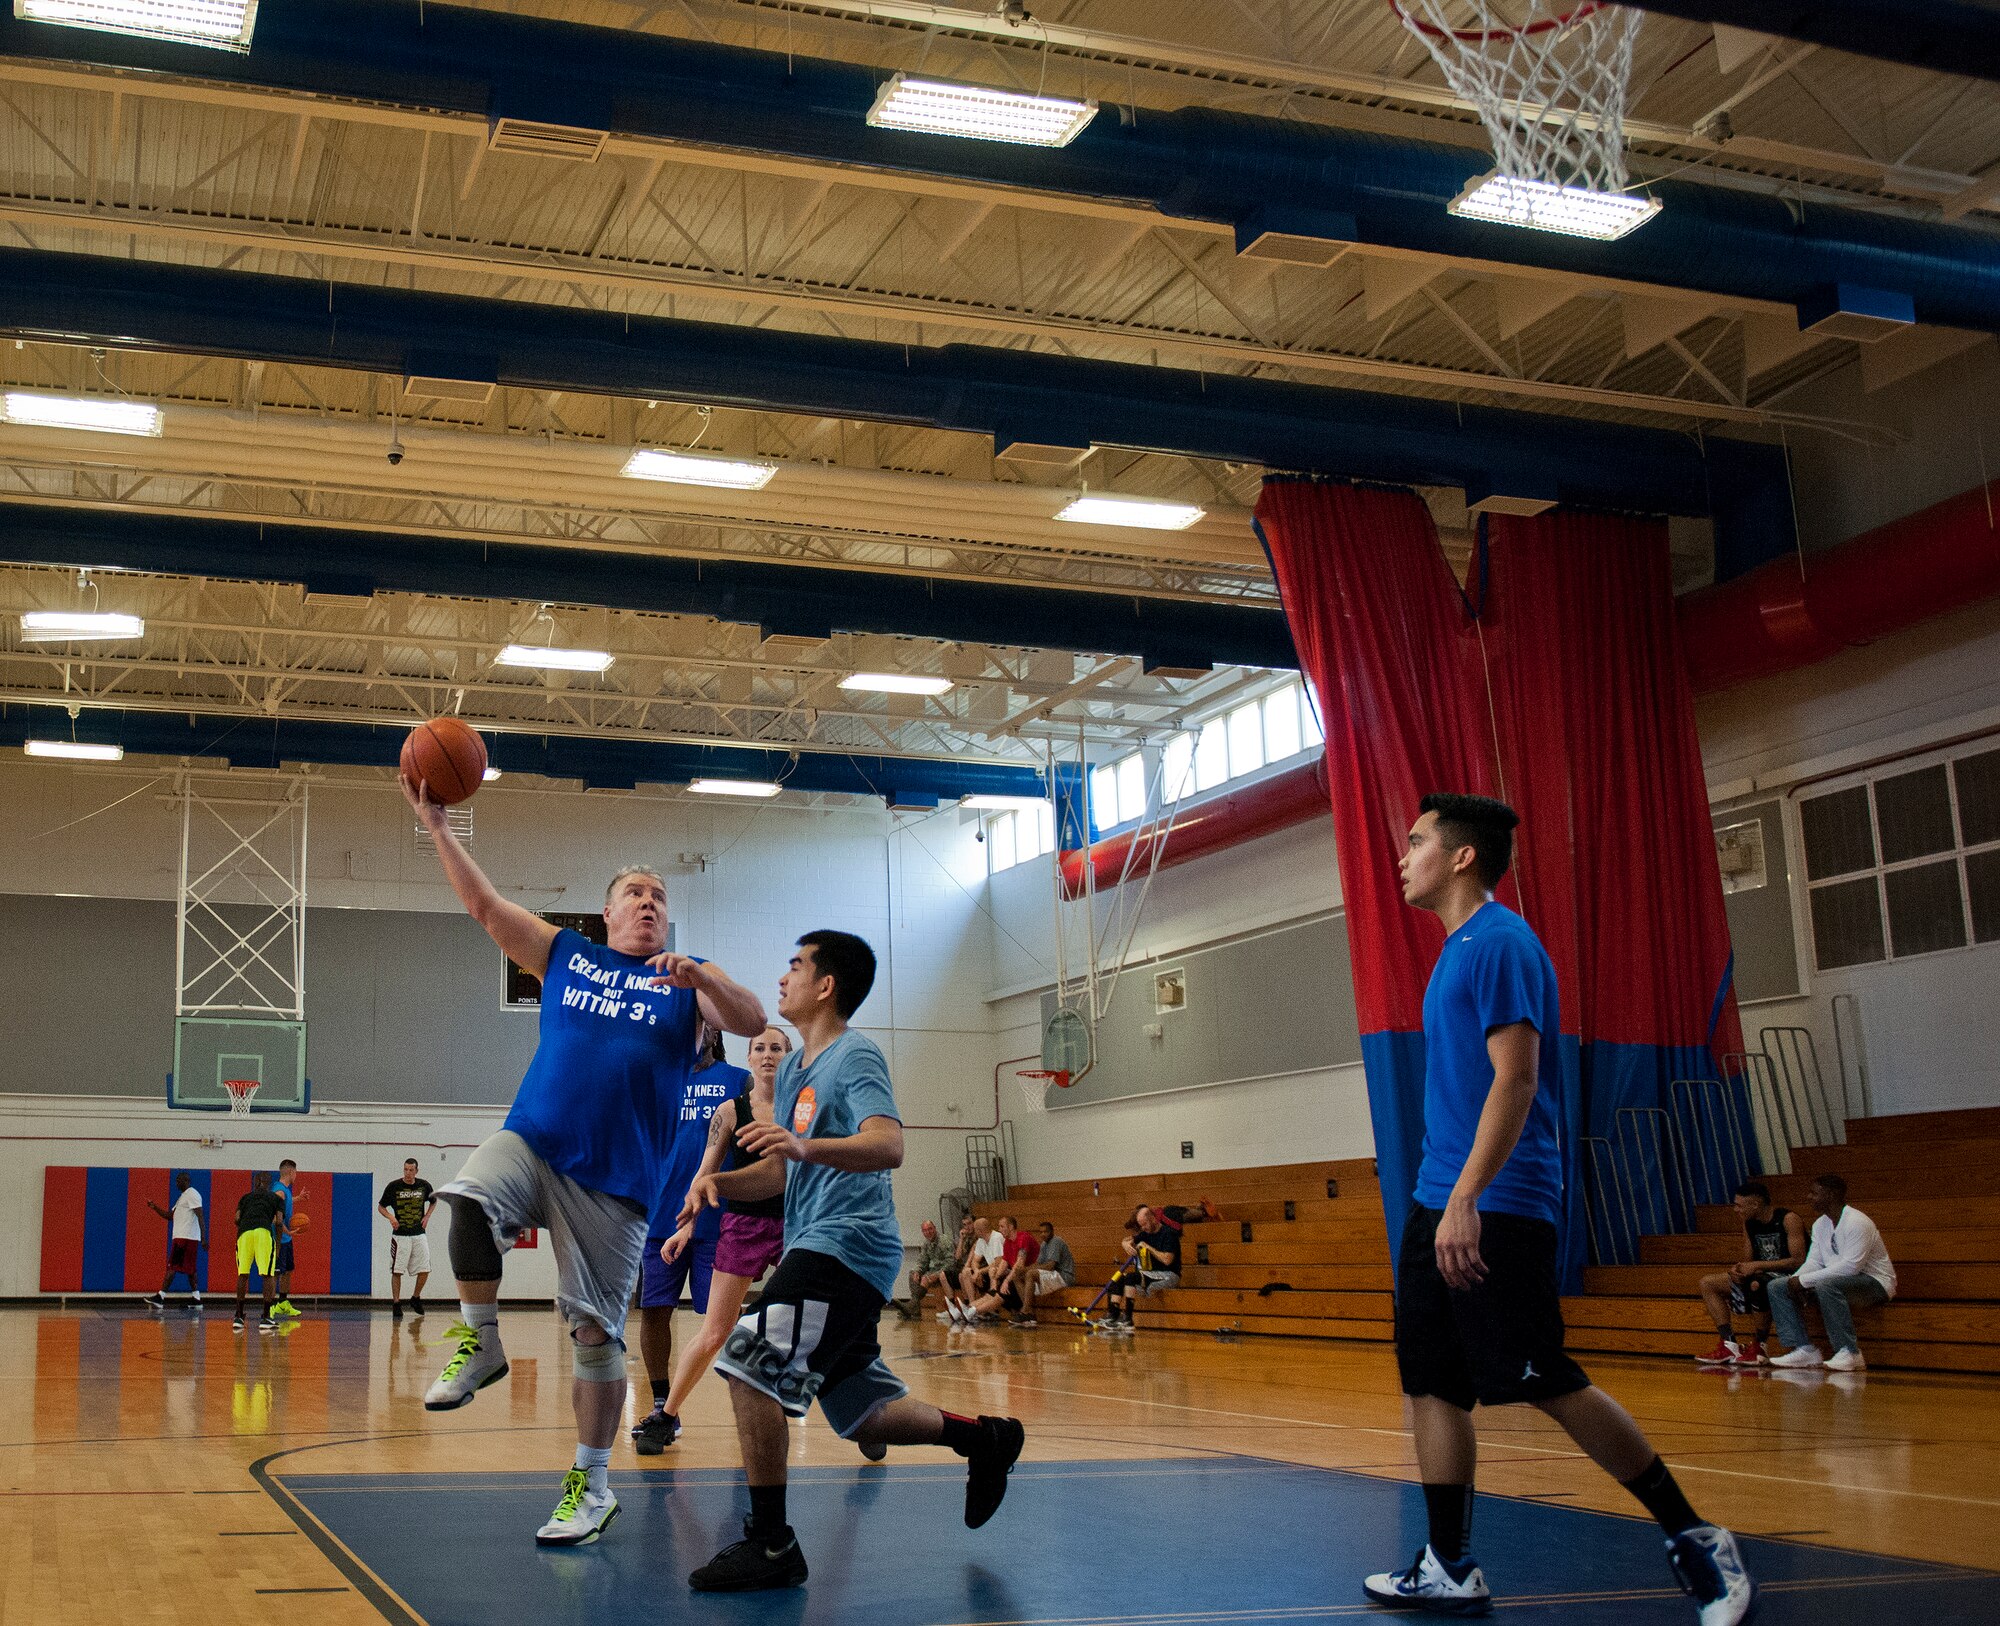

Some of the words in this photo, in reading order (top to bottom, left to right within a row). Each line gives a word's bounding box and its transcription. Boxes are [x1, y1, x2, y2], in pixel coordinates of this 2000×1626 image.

[568, 953, 620, 987] CREAKY
[603, 988, 623, 999] BUT
[562, 986, 627, 1018] HITTIN'
[695, 1084, 726, 1097] KNEES
[684, 1098, 697, 1106] BUT
[680, 1106, 700, 1120] TIN'
[702, 1105, 716, 1120] 3'
